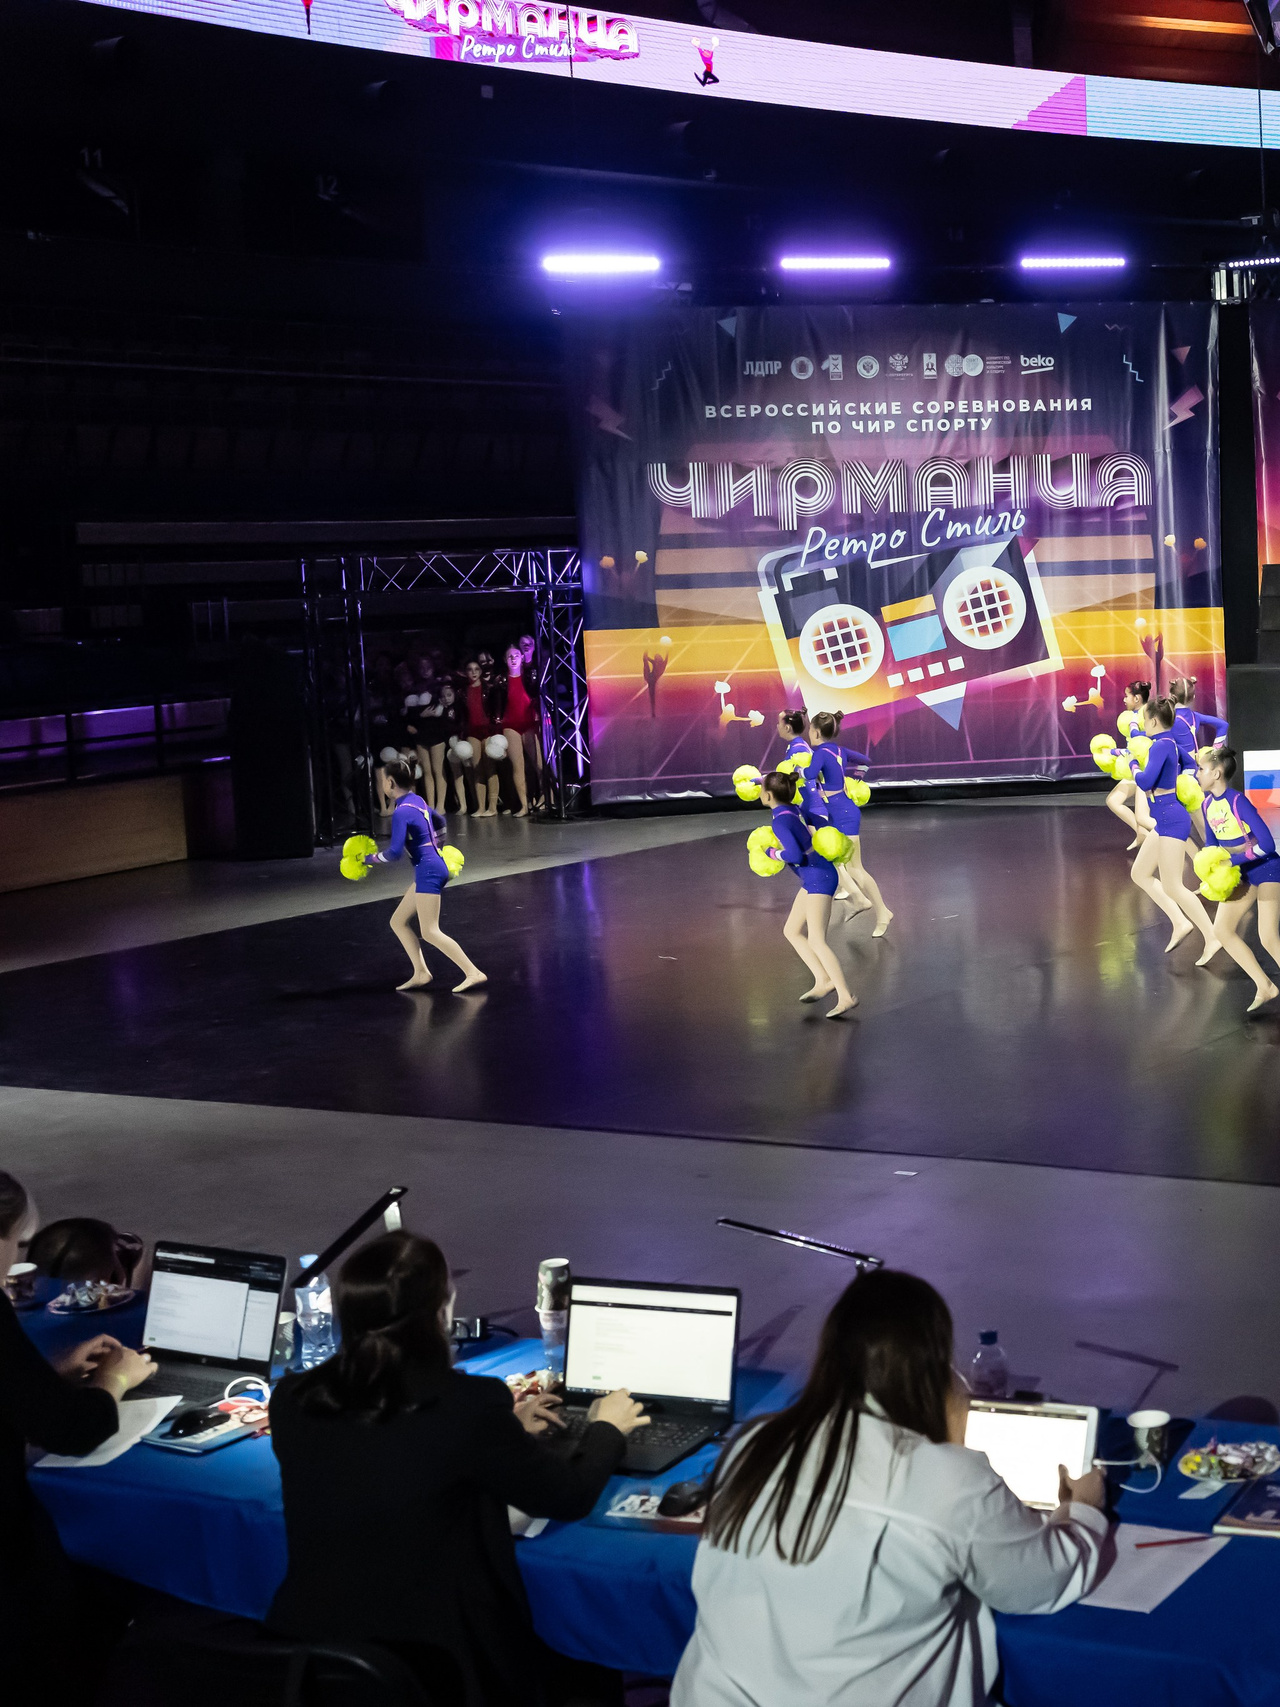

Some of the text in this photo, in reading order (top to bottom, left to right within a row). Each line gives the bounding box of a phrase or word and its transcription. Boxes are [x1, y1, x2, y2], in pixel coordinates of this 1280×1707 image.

[460, 34, 517, 63] Ретро
[743, 360, 782, 377] ЛДПР
[1020, 354, 1055, 367] beko
[705, 398, 1092, 419] ВСЕРОССИЙСКИЕ СОРЕВНОВАНИЯ
[811, 417, 993, 434] ПО ЧИР СПОРТУ
[800, 507, 1026, 568] Ретро Стиль
